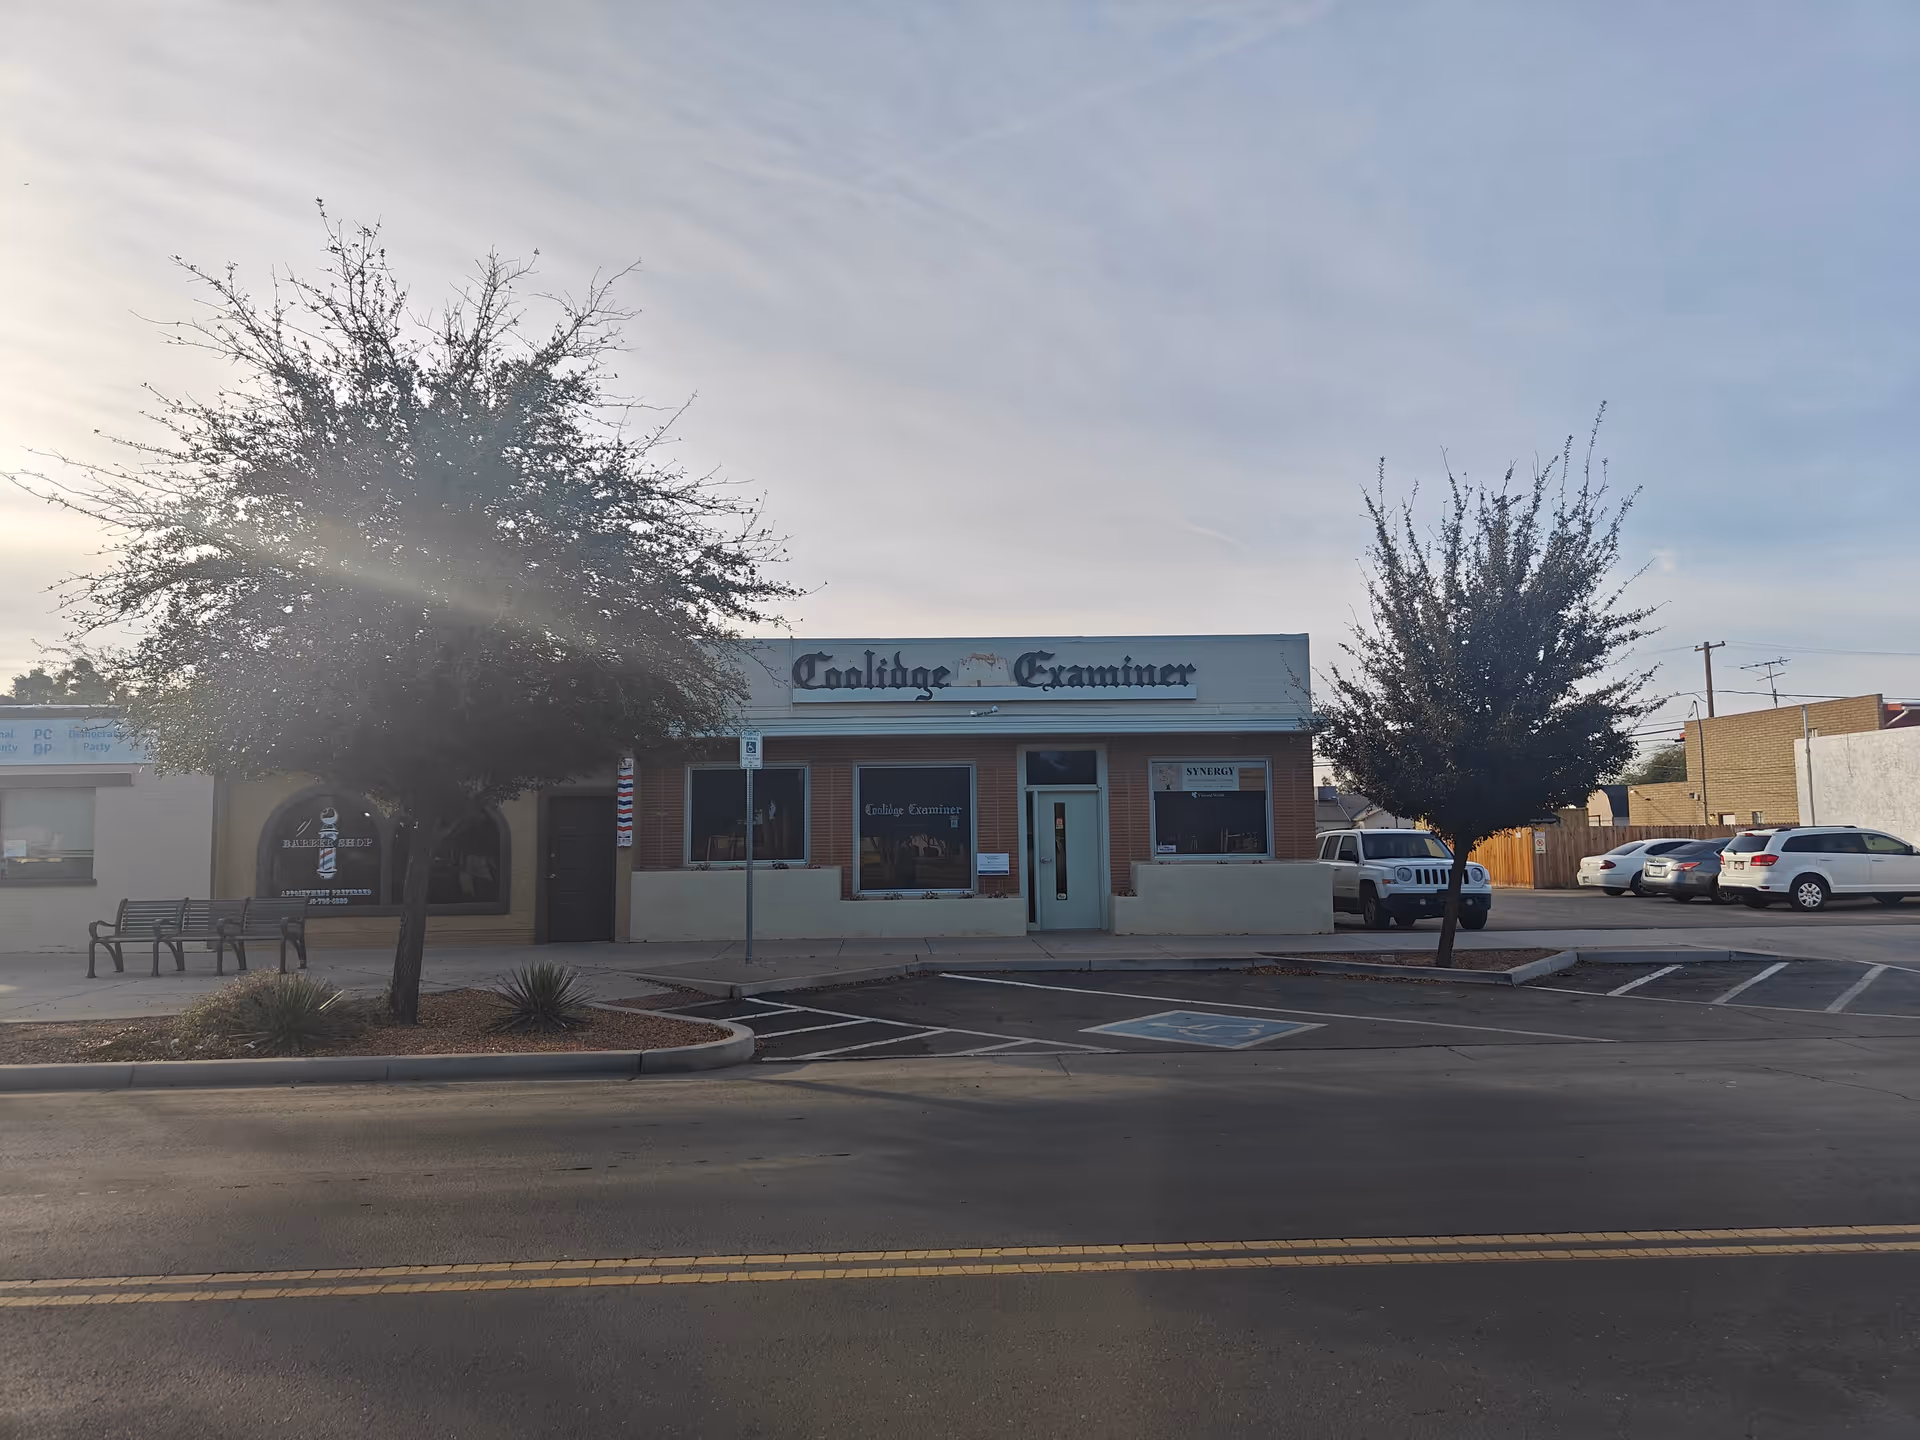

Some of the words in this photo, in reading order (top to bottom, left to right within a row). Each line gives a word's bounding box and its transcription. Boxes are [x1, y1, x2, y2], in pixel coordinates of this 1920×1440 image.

[792, 649, 951, 701] Coolidge
[1013, 650, 1196, 692] Examiner
[34, 728, 53, 740] PC
[83, 742, 111, 752] Party
[1186, 766, 1235, 776] SYNERGY
[865, 803, 905, 817] Coolidge
[908, 803, 963, 815] Examiner
[282, 839, 334, 848] BARBER
[338, 838, 373, 847] SHOP
